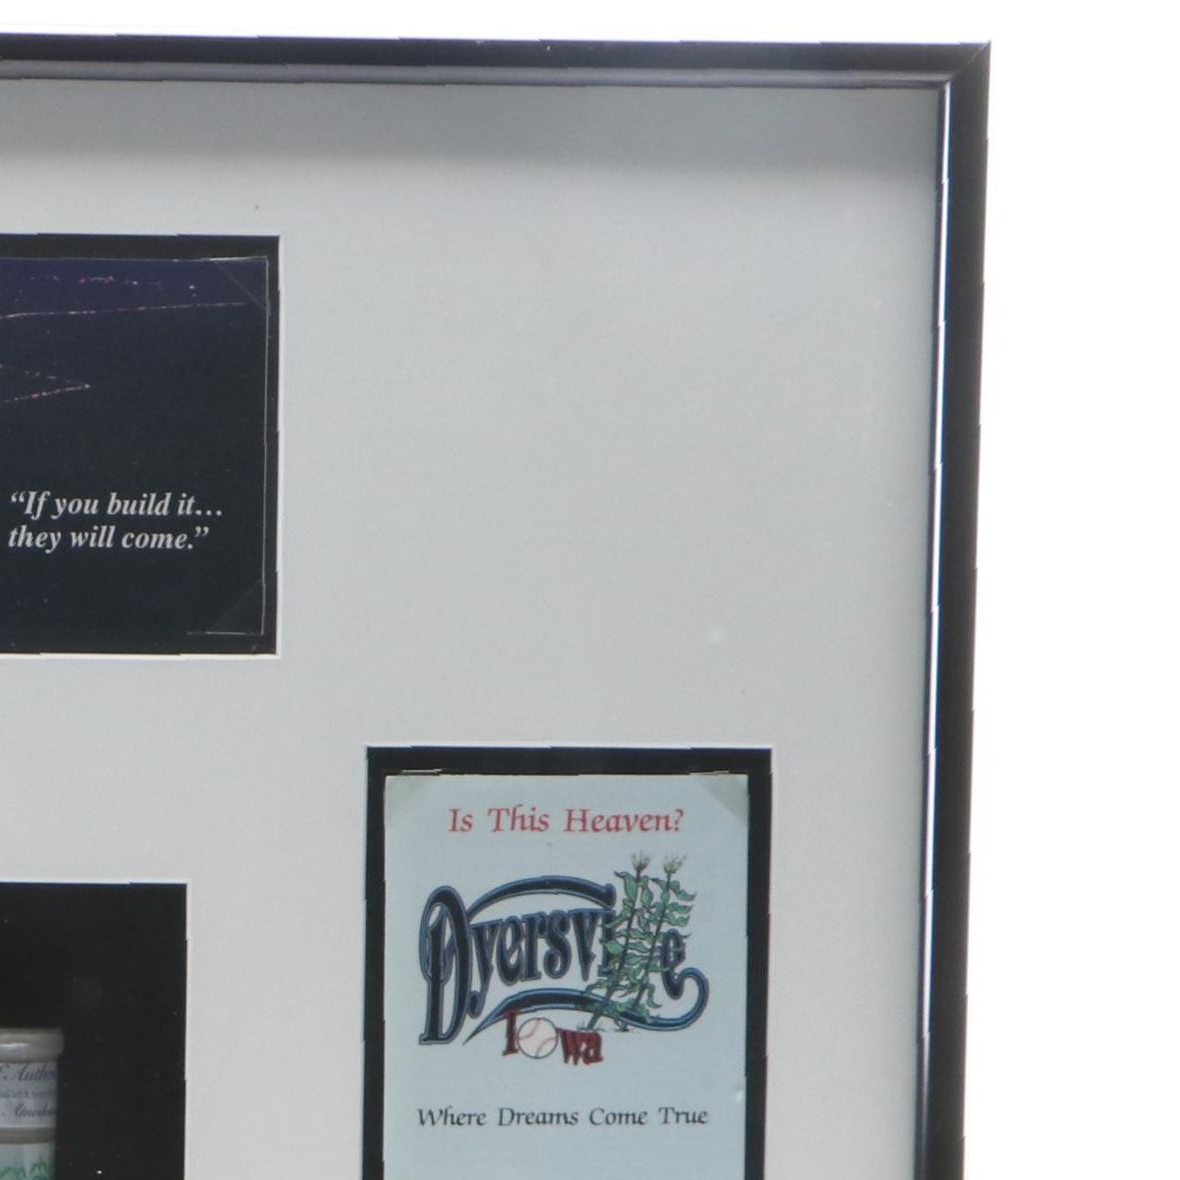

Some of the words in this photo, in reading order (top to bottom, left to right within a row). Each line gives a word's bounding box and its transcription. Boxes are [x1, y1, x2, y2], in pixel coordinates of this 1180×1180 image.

[11, 491, 51, 520] “If
[51, 498, 99, 520] you
[107, 492, 172, 516] build
[8, 525, 62, 554] they
[70, 525, 117, 549] will
[121, 526, 210, 550] come.”
[448, 808, 474, 833] Is
[487, 804, 550, 833] This
[563, 808, 686, 833] Heaven?
[417, 1105, 487, 1126] Where
[498, 1107, 579, 1126] Dreams
[589, 1107, 649, 1126] Come
[659, 1106, 709, 1125] True
